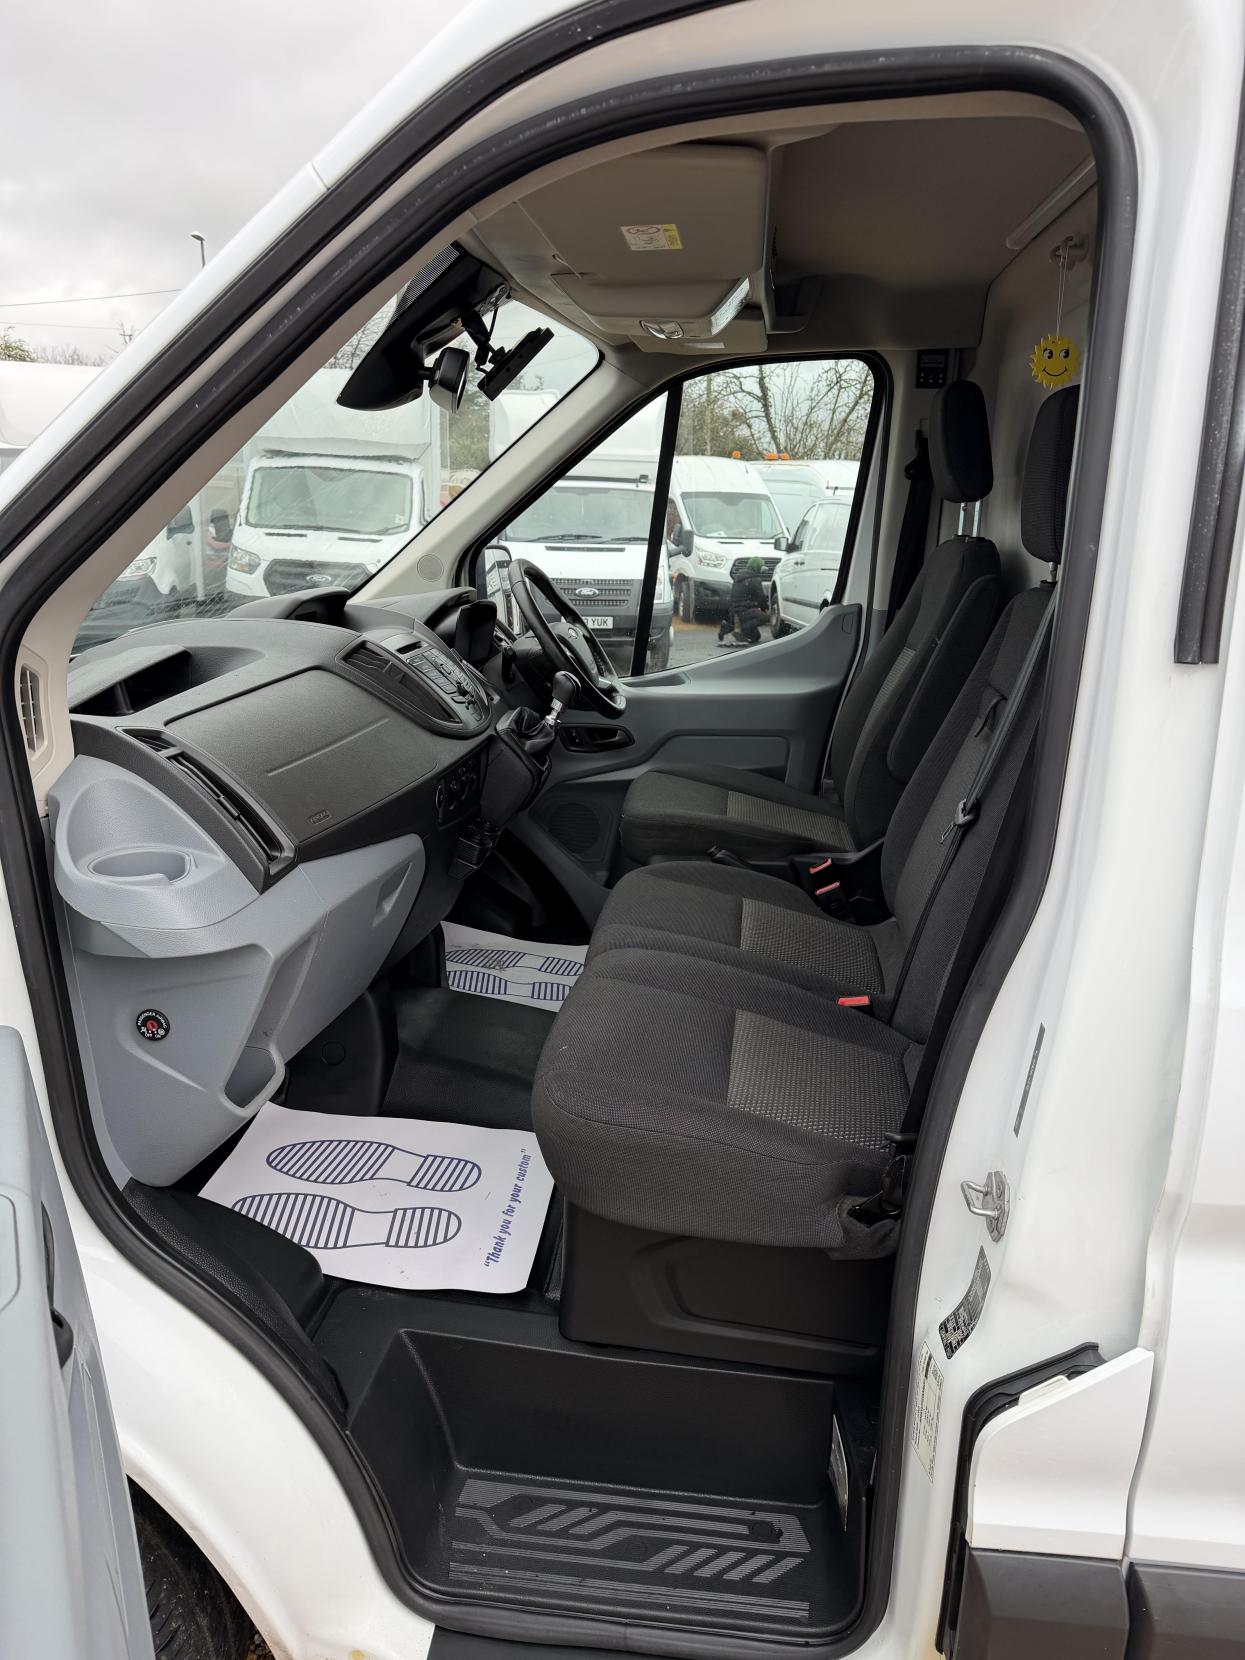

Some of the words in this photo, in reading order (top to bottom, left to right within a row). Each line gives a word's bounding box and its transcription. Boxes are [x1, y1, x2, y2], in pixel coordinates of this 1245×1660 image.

[591, 618, 608, 626] YUK
[510, 1183, 523, 1203] your
[502, 1204, 516, 1217] for
[499, 1218, 512, 1236] you
